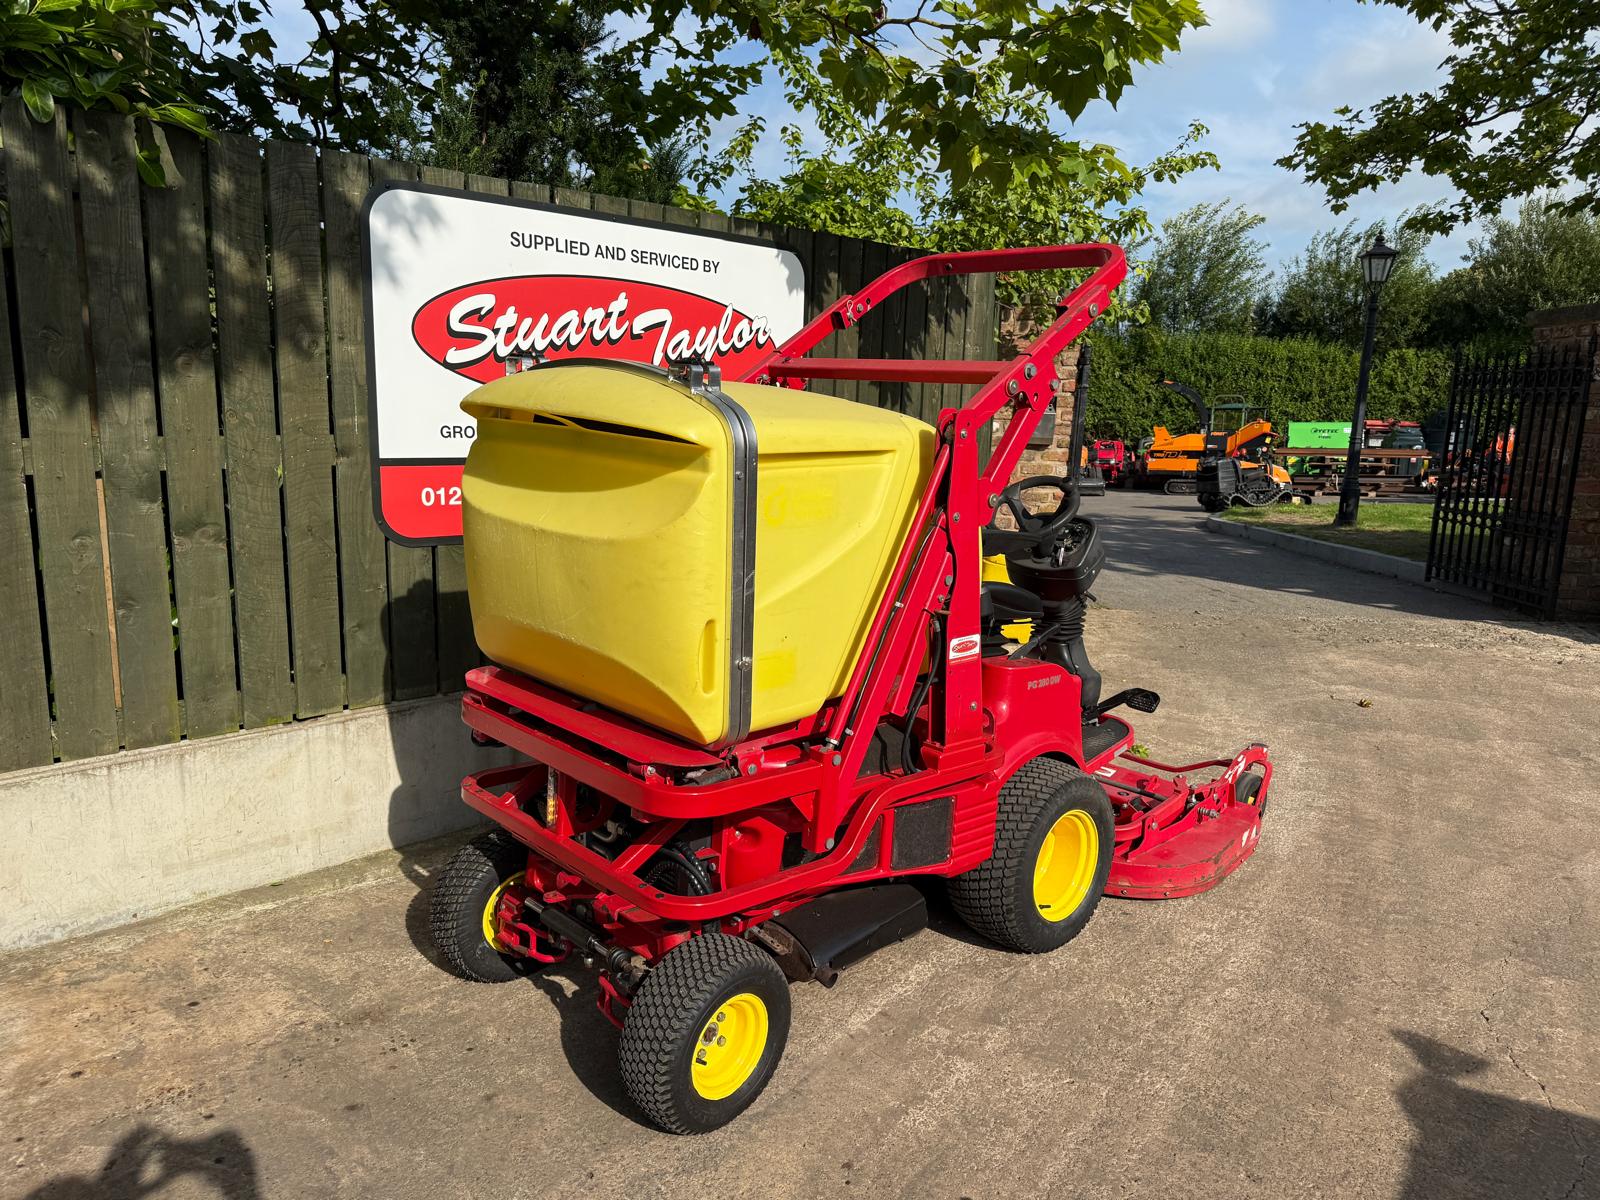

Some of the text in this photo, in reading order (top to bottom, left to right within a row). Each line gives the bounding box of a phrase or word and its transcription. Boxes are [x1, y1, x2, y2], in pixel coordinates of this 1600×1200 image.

[510, 231, 720, 274] SUPPLIED AND SERVICED BY
[444, 292, 772, 366] Stuart Taylor
[421, 486, 462, 507] 012
